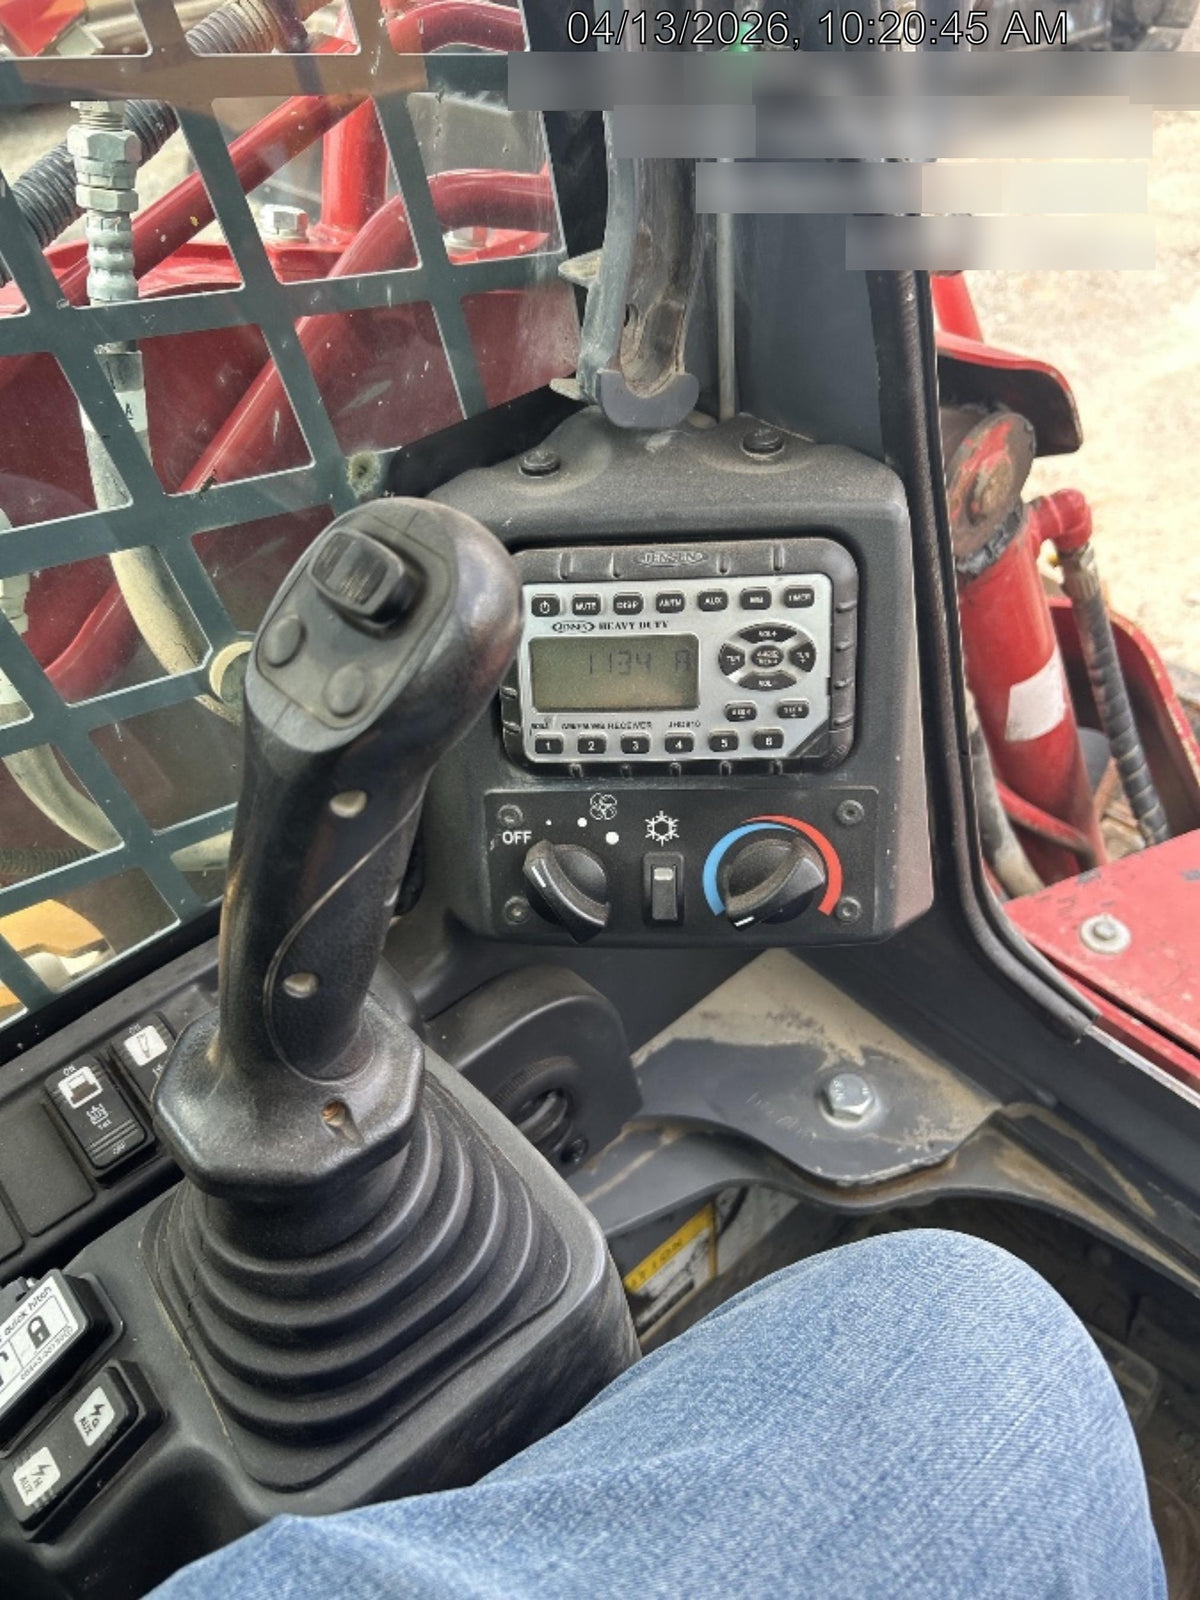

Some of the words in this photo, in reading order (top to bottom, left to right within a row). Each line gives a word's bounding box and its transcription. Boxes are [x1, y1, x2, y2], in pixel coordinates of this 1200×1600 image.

[575, 602, 597, 611] MUTE
[598, 620, 636, 631] HEAVY
[639, 620, 669, 630] DUTY
[588, 741, 596, 751] 2
[632, 741, 640, 751] 3
[674, 740, 683, 750] 4
[721, 738, 728, 748] 5
[765, 736, 773, 746] 6
[545, 742, 552, 751] 1
[501, 831, 532, 845] OFF
